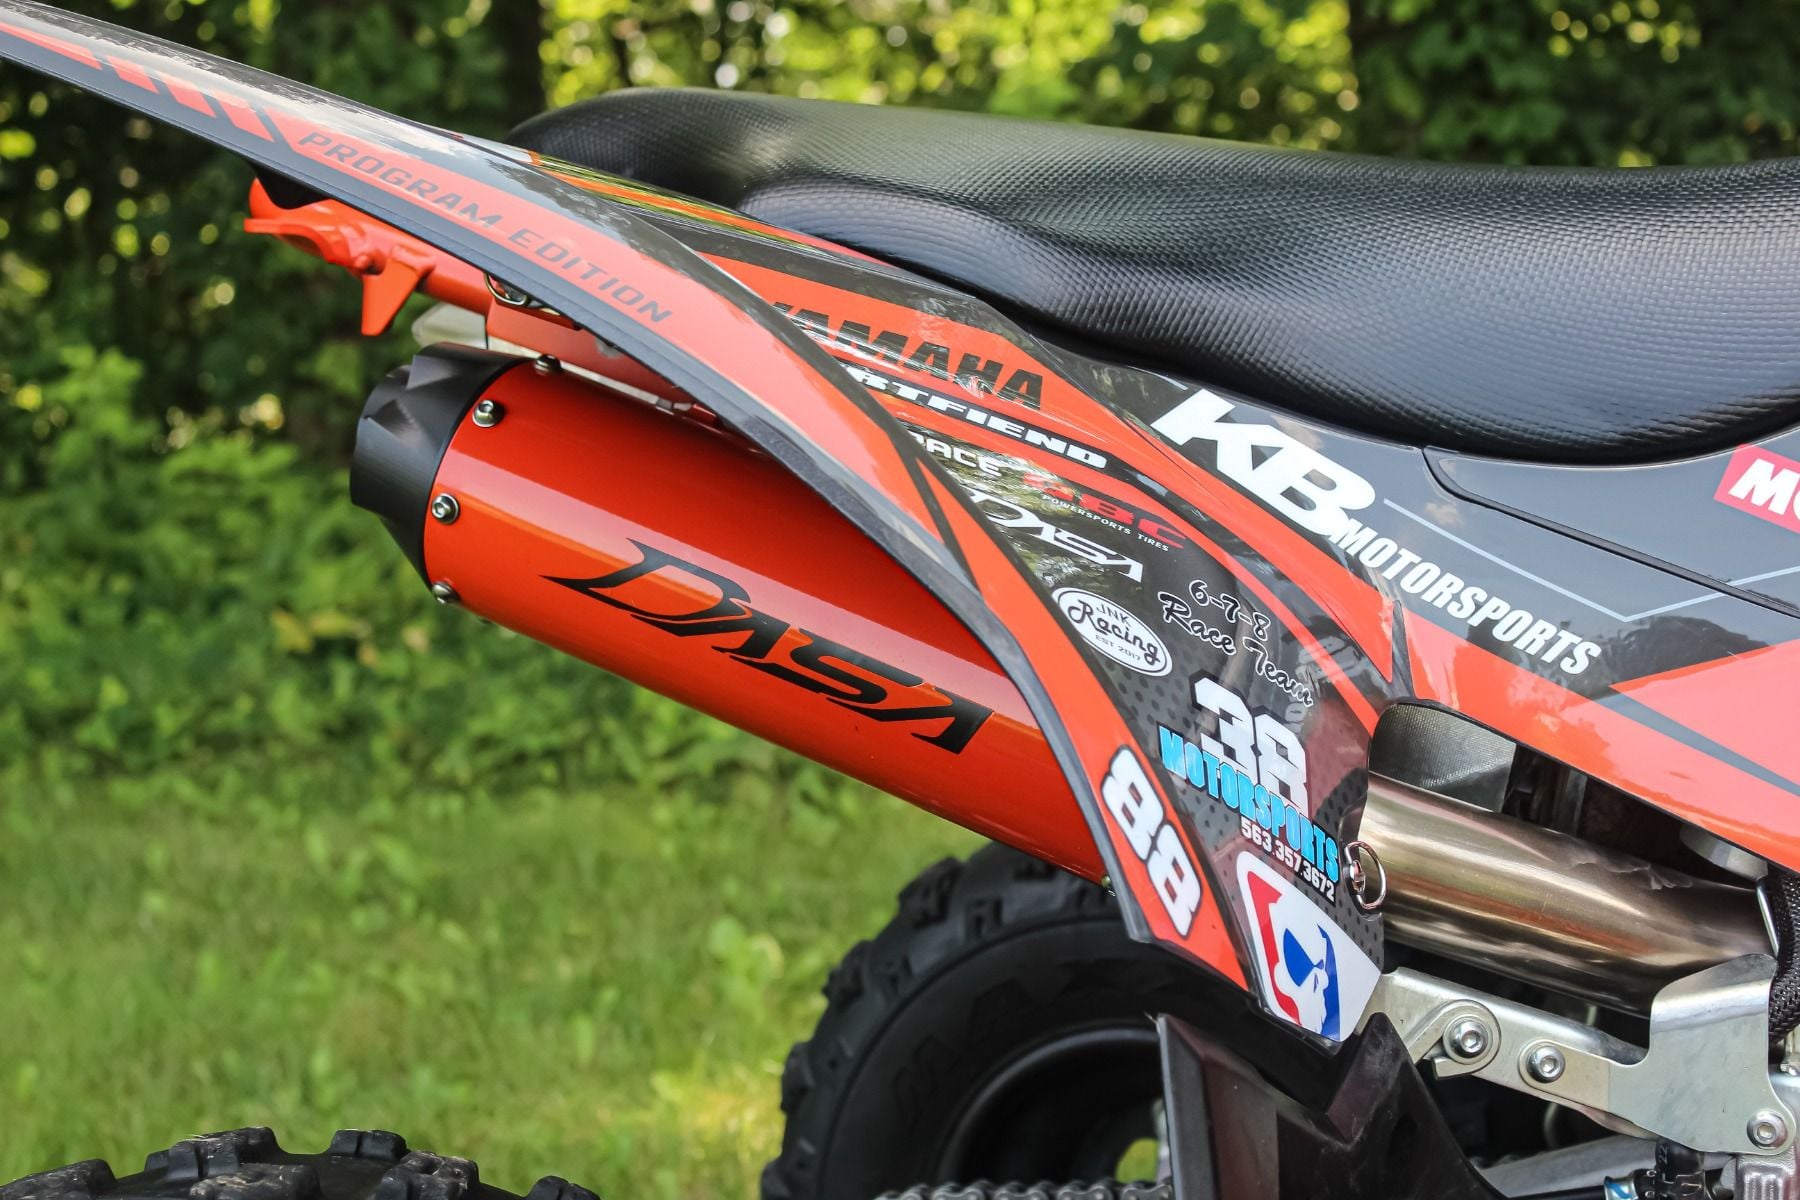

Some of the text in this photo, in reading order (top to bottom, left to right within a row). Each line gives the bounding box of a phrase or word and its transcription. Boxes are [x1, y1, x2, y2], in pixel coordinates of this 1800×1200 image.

[298, 131, 673, 323] PROGRAM EDITION
[772, 301, 1044, 411] AMAHA
[1151, 388, 1376, 537] KB
[1727, 458, 1800, 521] M
[1042, 494, 1170, 552] POWERSPORTS TIRES
[538, 537, 994, 755] DASA
[1067, 599, 1161, 666] Racing
[1095, 603, 1132, 628] JNK
[1095, 634, 1142, 661] EST 2017
[1157, 591, 1314, 708] Race Team
[1188, 579, 1271, 642] 6-7-8
[1330, 517, 1603, 676] MOTORSPORTS
[1101, 747, 1201, 937] 88
[1157, 723, 1340, 886] MOTORSPORTS
[1240, 815, 1336, 903] 563.357.3672
